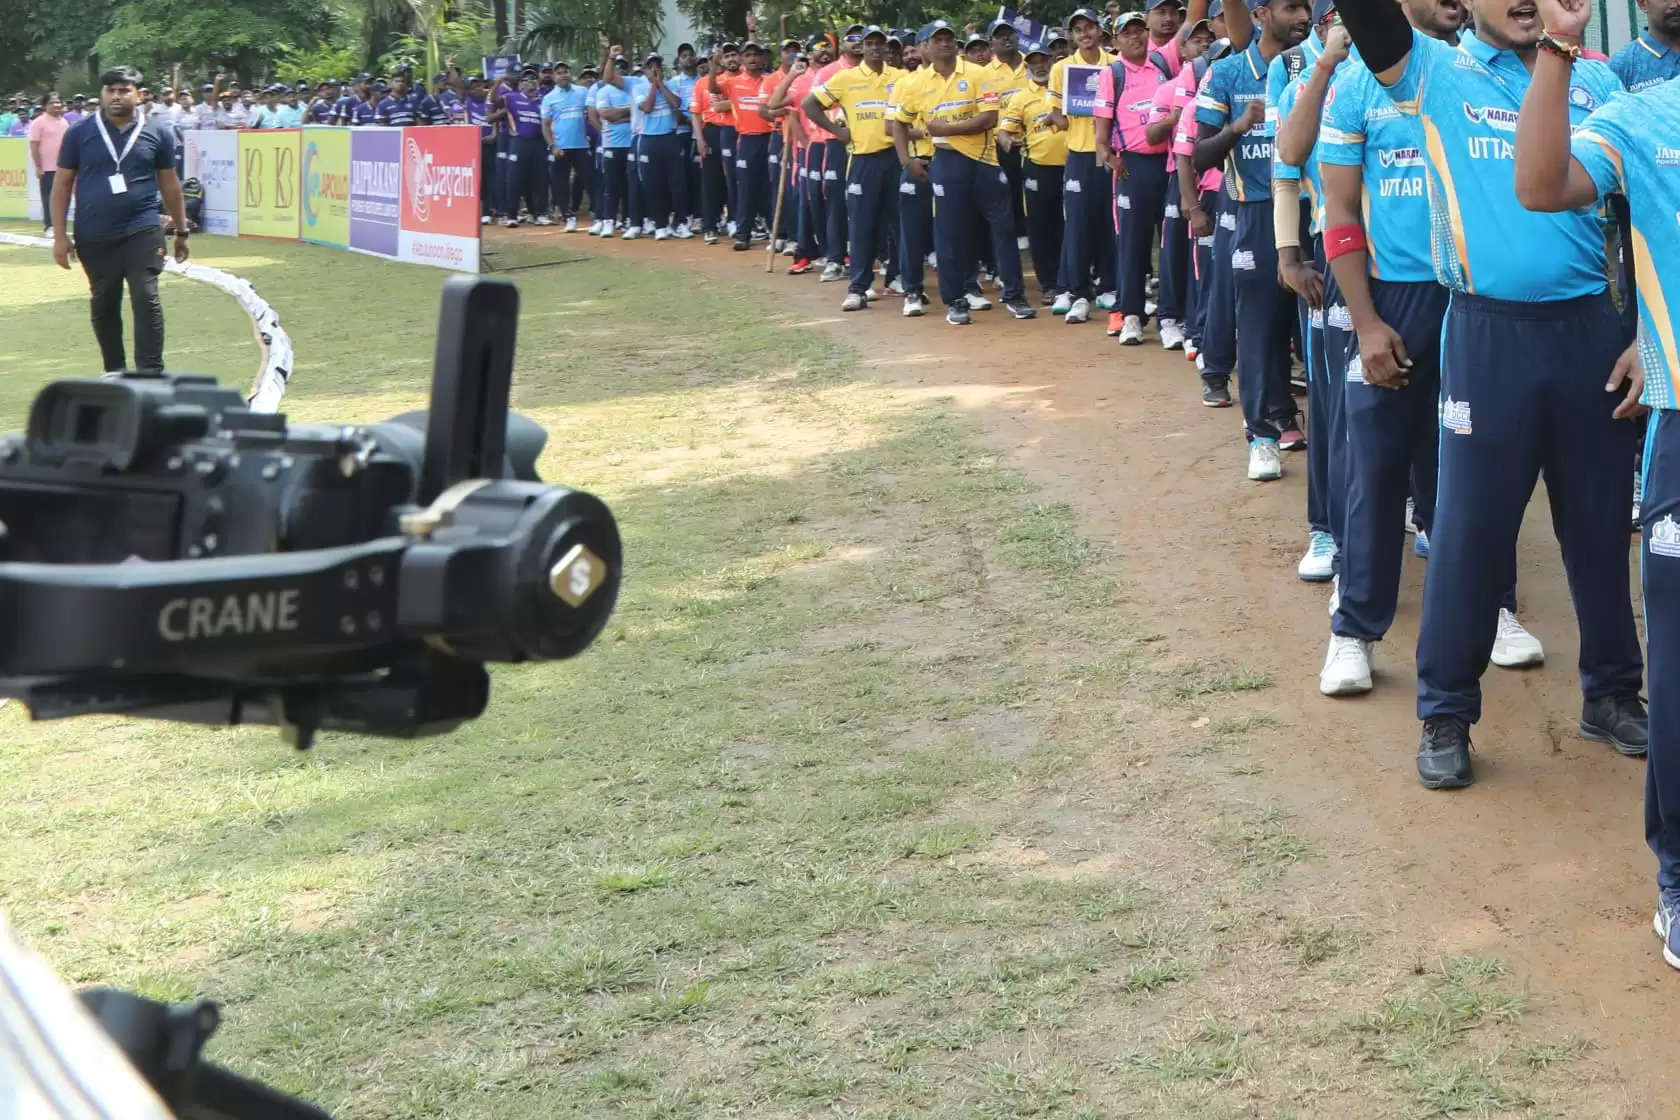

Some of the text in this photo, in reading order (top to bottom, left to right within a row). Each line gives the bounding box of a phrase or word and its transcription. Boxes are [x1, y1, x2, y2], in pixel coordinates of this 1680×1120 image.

[1288, 55, 1301, 81] afari
[1487, 109, 1519, 124] NARAY
[1242, 144, 1273, 160] KAR
[1395, 149, 1420, 160] NARAY
[1468, 136, 1516, 160] UTTA
[158, 589, 300, 642] CRANE
